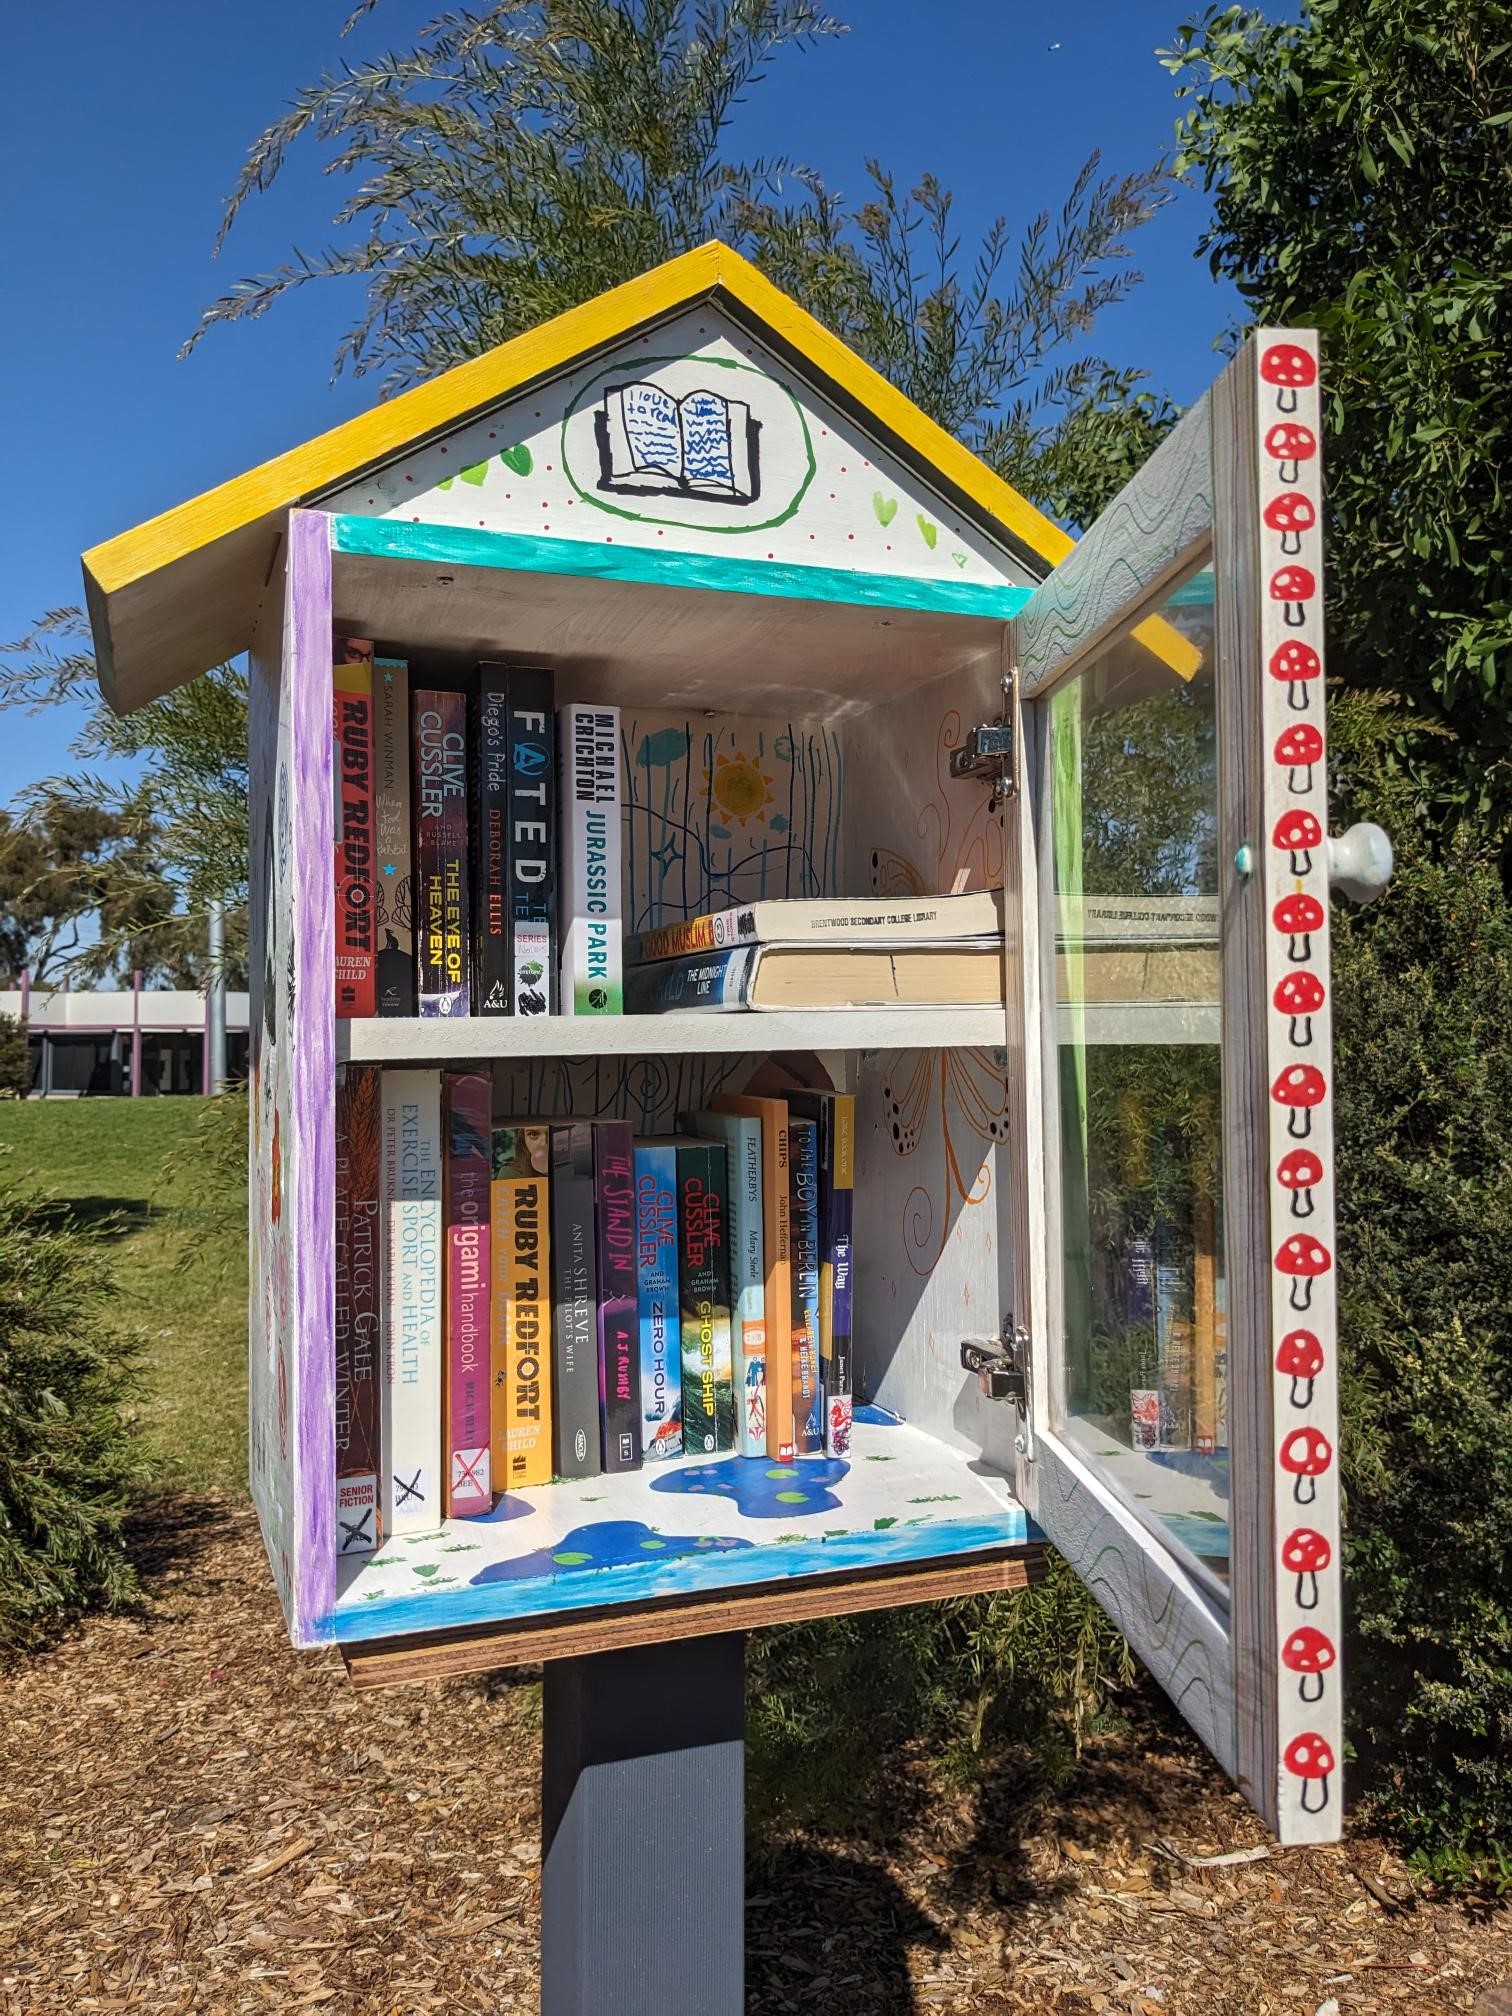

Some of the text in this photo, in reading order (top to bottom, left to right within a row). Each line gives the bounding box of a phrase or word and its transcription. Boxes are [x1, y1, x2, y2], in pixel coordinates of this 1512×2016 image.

[627, 402, 677, 427] to read
[639, 391, 669, 409] love
[383, 686, 394, 790] SARAH WINMAN
[420, 711, 443, 818] CUSSLER
[442, 732, 465, 798] CLIVE
[481, 692, 507, 792] Diego's Pride
[575, 713, 596, 802] CRICHTON
[595, 713, 616, 804] MICHAEL
[513, 710, 550, 883] FATED
[343, 700, 371, 952] RUBY REDFORT
[431, 839, 457, 847] BLAKE
[489, 809, 502, 936] DEBORAH ELLIS
[586, 810, 608, 979] JURASSIC PARK
[429, 875, 443, 966] HEAVEN
[446, 858, 461, 983] THE EYE OF
[517, 934, 547, 943] SERIES
[645, 932, 670, 958] GOOD
[671, 921, 707, 953] MUSLIM
[811, 911, 938, 929] BRENTWOOD SECONDARY COLLEGE LIBRARY
[335, 956, 372, 968] AUREN
[687, 964, 728, 982] THE MIDNIGHT
[696, 981, 711, 995] LINE
[483, 1000, 508, 1009] A&U
[386, 1108, 396, 1123] DR
[386, 1127, 396, 1157] PETER
[386, 1160, 396, 1211] BRUKNER
[747, 1136, 758, 1203] FEATHERBYS
[602, 1155, 635, 1272] THE STAND IN
[637, 1175, 657, 1268] CUSSLER
[656, 1191, 674, 1247] CLIVE
[685, 1177, 704, 1268] CUSSLER
[703, 1192, 721, 1248] CLIVE
[778, 1130, 789, 1265] CHIPS John Heffernan
[796, 1130, 817, 1298] TO THE BOY IN BERLIN
[402, 1205, 418, 1268] SPORT
[420, 1140, 436, 1346] THE ENCYCLOPEDIA OF
[749, 1230, 759, 1254] Mary
[834, 1234, 849, 1289] The Way
[353, 1200, 379, 1382] PATRICK GALE
[402, 1272, 413, 1301] AND
[453, 1171, 487, 1373] the origami handbook
[498, 1248, 510, 1282] YOUR
[572, 1223, 589, 1344] ANITA SHREVE
[643, 1278, 671, 1286] GRAHAM
[646, 1285, 670, 1293] BROWN
[691, 1278, 719, 1286] GRAHAM
[693, 1285, 717, 1293] BROWN
[749, 1254, 760, 1279] Steele
[514, 1184, 540, 1420] RUBY REDFORT
[563, 1268, 574, 1374] THE PILOT'S WIFE
[386, 1320, 396, 1349] JOHN
[402, 1305, 418, 1384] HEALTH
[652, 1302, 665, 1414] ZERO HOUR
[700, 1300, 715, 1417] GHOST SHIP
[386, 1354, 396, 1384] KRON
[616, 1356, 631, 1400] RUMBY
[837, 1354, 846, 1374] Janet
[335, 1348, 350, 1450] WINTER
[499, 1424, 541, 1440] LAUREN
[501, 1438, 537, 1452] CHILD
[801, 1428, 820, 1437] A&U
[339, 1495, 374, 1508] FICTION
[340, 1484, 373, 1498] SENIOR
